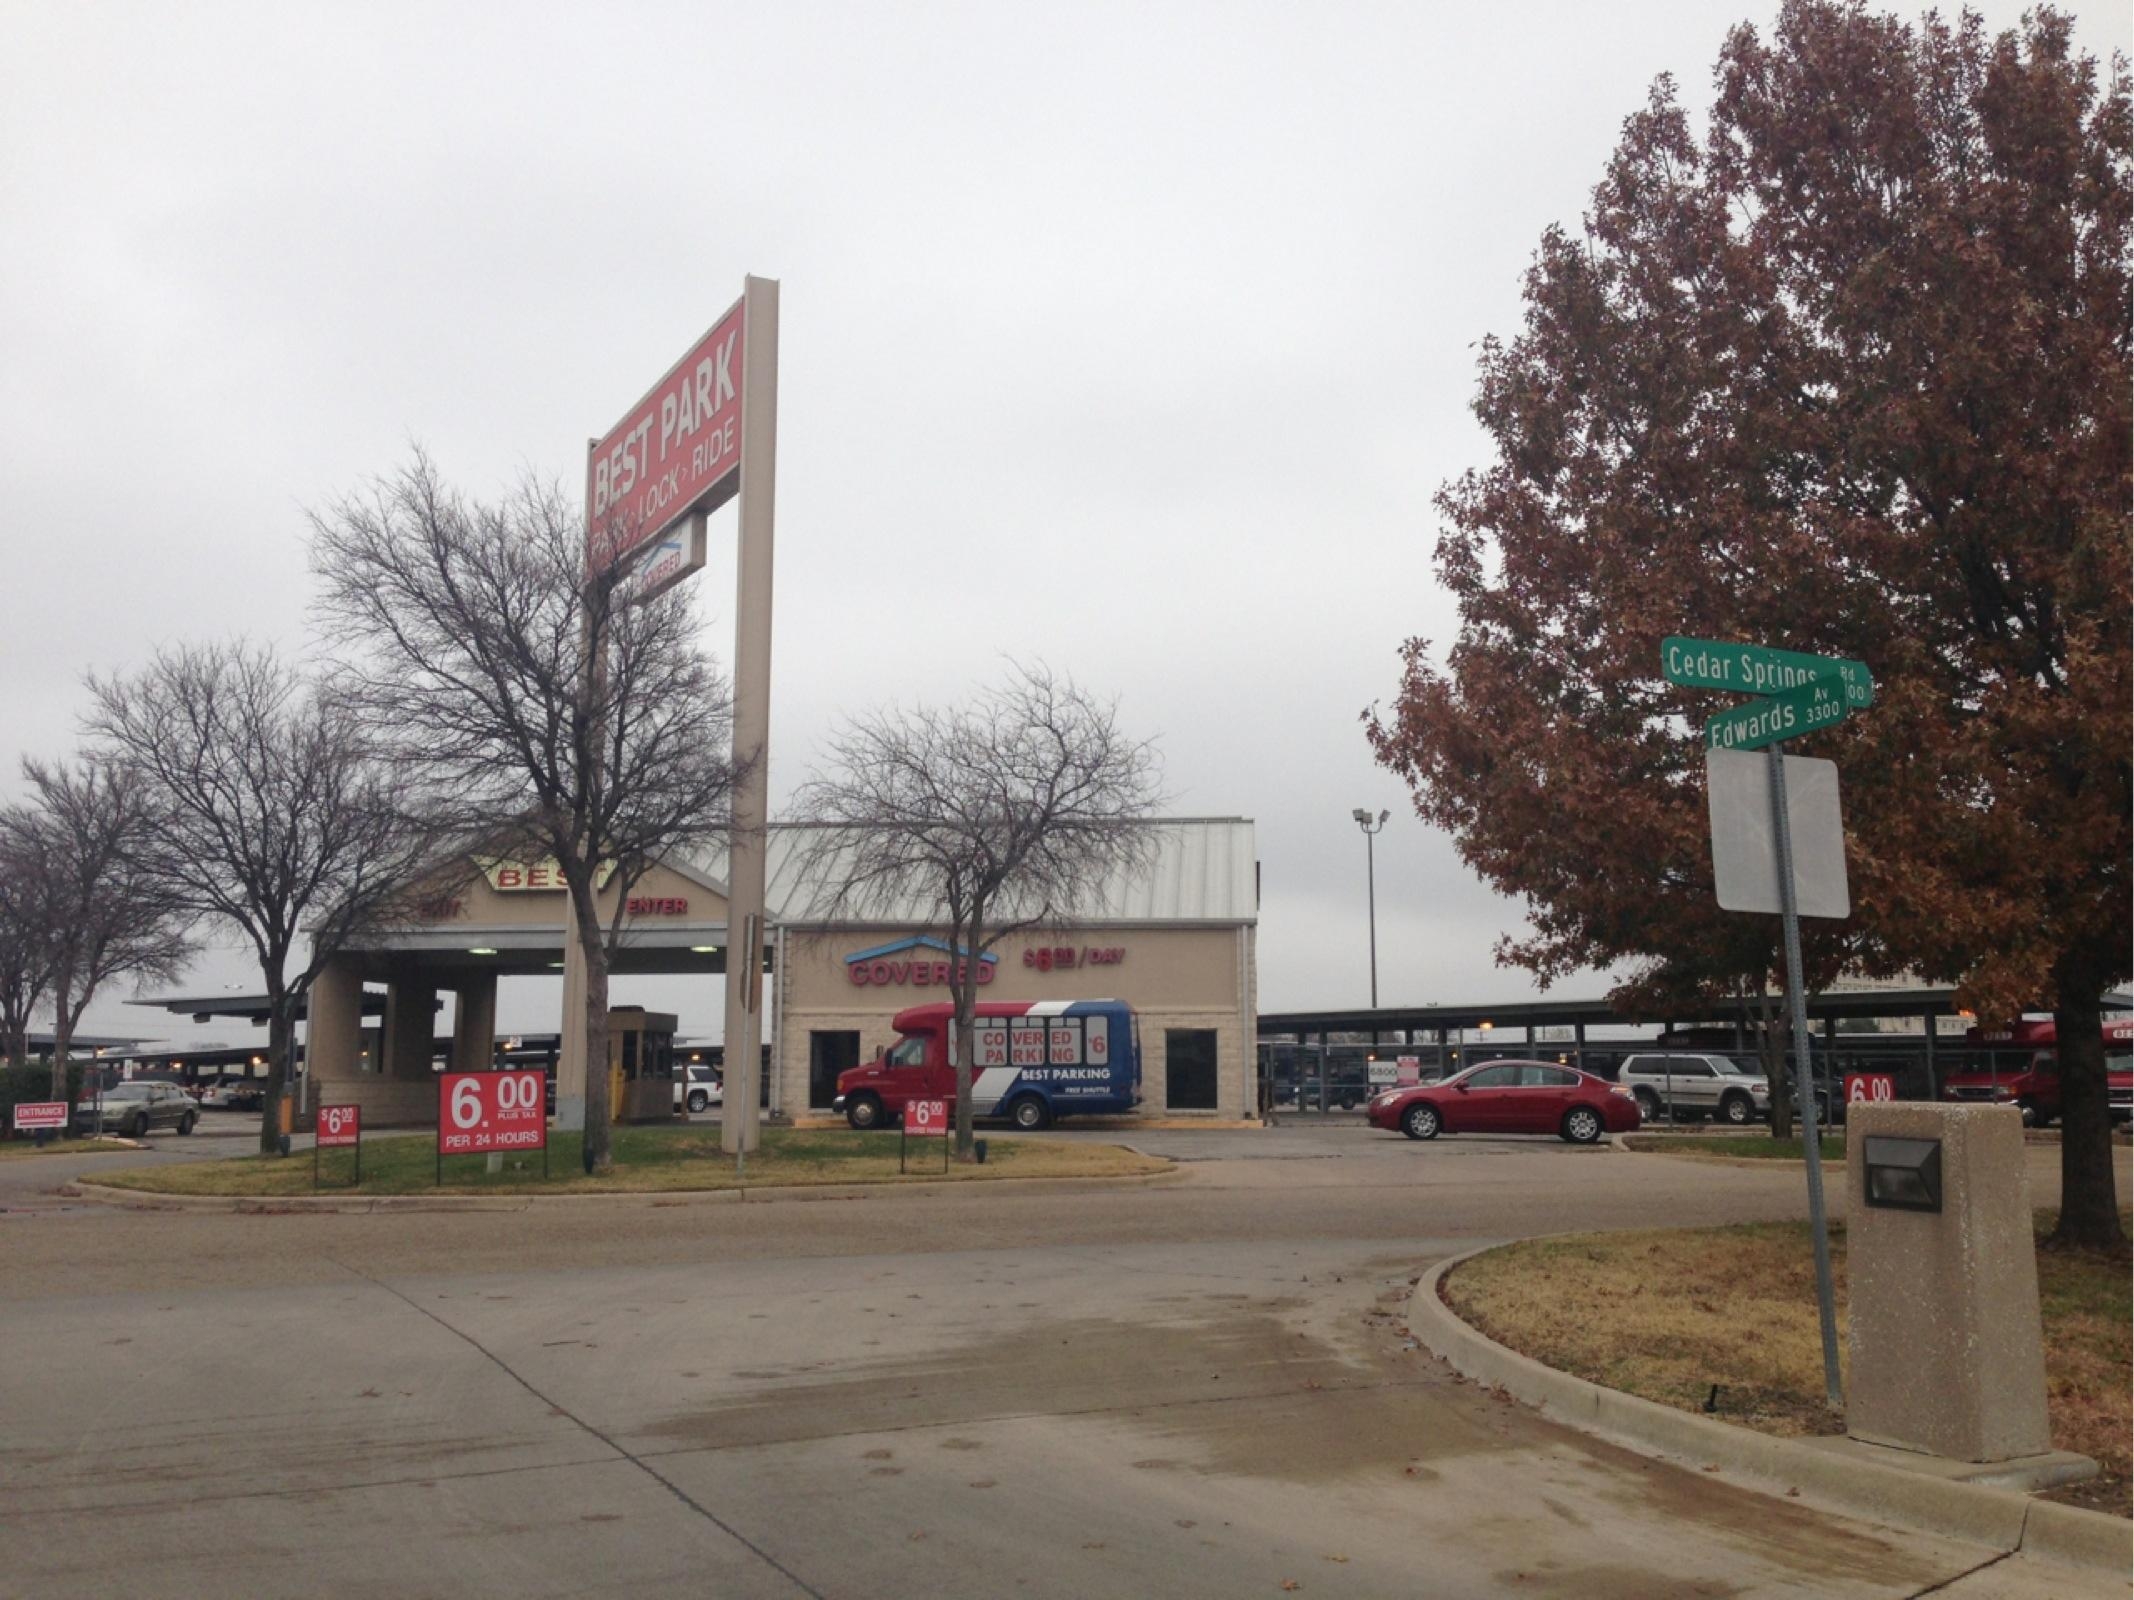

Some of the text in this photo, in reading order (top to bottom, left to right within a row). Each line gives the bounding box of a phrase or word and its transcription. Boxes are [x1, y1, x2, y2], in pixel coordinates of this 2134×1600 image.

[594, 328, 738, 518] BEST PARK
[638, 463, 681, 526] LOCK
[692, 416, 736, 482] RIDE
[1669, 646, 1856, 689] Cedar Springs Rd
[1815, 687, 1829, 702] Av
[1711, 701, 1840, 749] Edwards 3300
[626, 898, 688, 914] ENTER
[848, 960, 995, 985] COVERED
[982, 1031, 1072, 1047] COVERED
[985, 1048, 1074, 1064] PARKING
[1021, 1068, 1111, 1080] BEST PARKING
[18, 1107, 64, 1117] ENTRANCE
[522, 1111, 537, 1119] TAX
[446, 1130, 538, 1147] PER 24 HOURS
